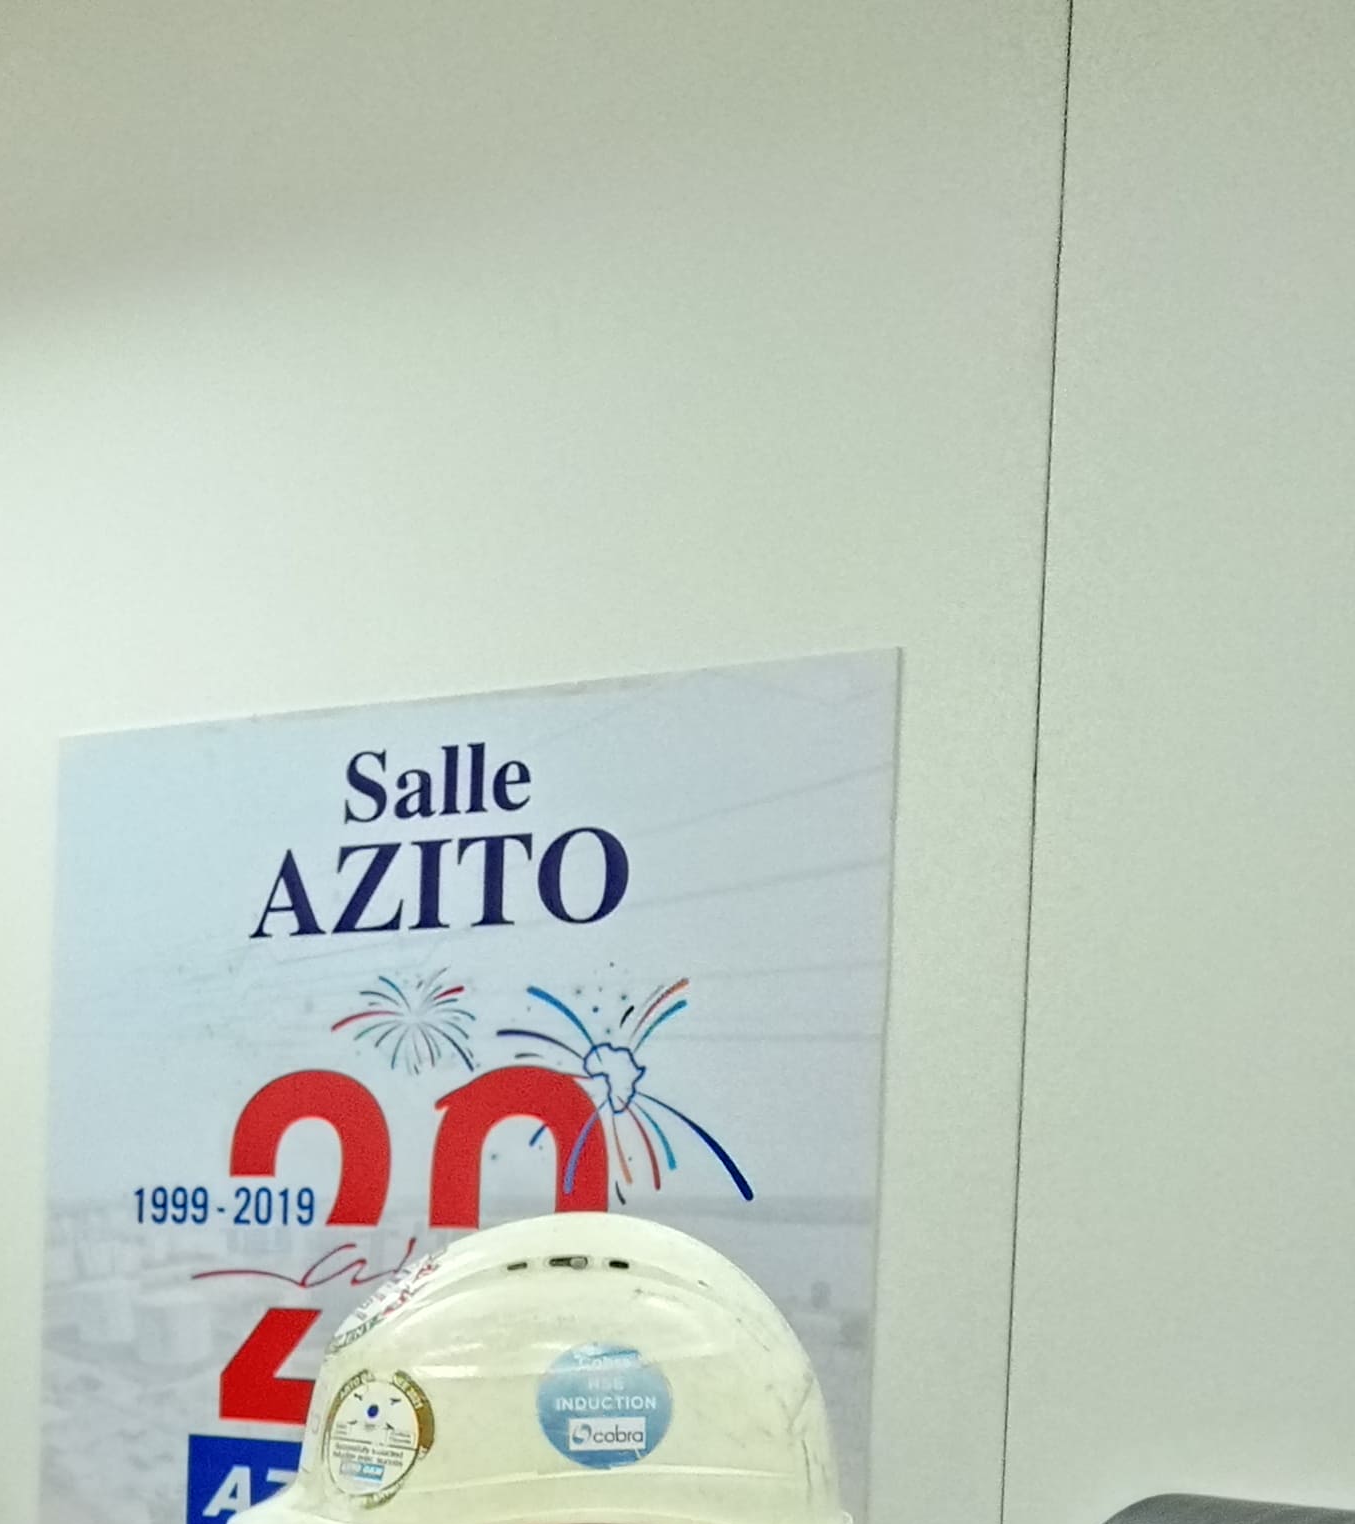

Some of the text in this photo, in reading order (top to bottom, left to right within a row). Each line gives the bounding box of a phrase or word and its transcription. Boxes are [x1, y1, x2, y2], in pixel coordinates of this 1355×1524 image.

[343, 741, 532, 825] Salle
[248, 825, 630, 939] AZITO
[555, 1395, 657, 1411] INDUCTION
[592, 1424, 644, 1444] cobra
